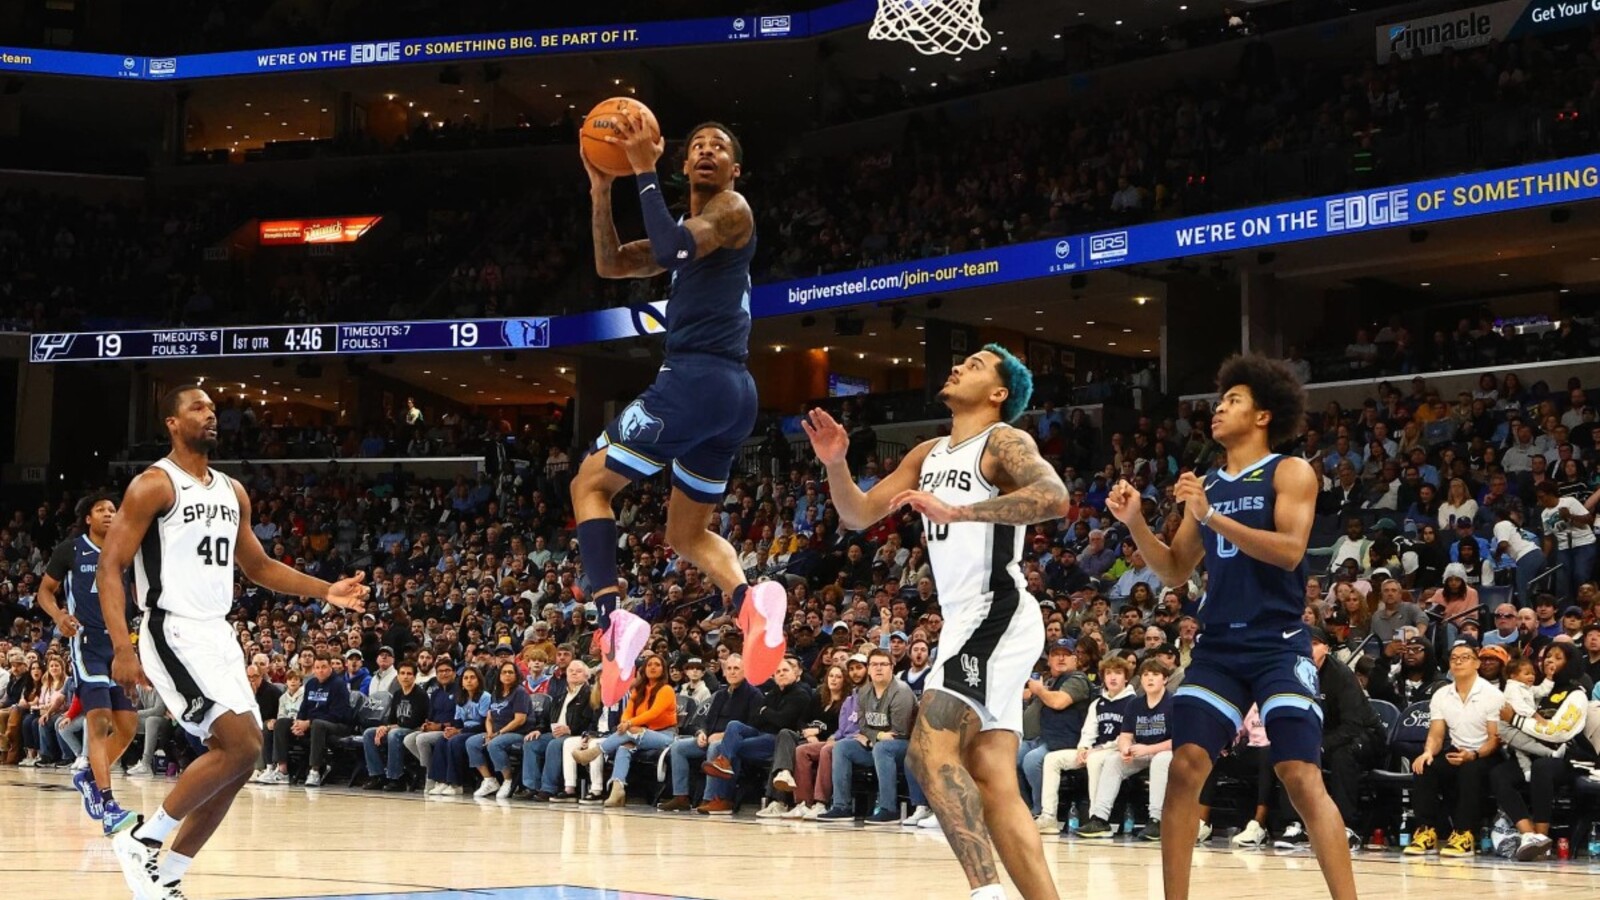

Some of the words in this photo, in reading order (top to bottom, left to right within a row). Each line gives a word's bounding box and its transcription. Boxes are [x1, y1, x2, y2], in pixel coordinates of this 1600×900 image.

[762, 17, 788, 27] BRS
[1531, 7, 1555, 23] Get
[1559, 1, 1588, 17] Your
[1388, 12, 1491, 52] Pinnacle
[257, 53, 295, 67] WE'RE
[299, 51, 318, 64] ON
[321, 49, 346, 62] THE
[350, 42, 400, 64] EDGE
[404, 44, 422, 57] OF
[425, 38, 506, 55] SOMETHING
[510, 36, 537, 49] BIG.
[541, 35, 558, 47] BE
[562, 32, 598, 45] PART
[601, 30, 619, 43] OF
[623, 29, 639, 41] IT.
[1176, 222, 1236, 247] WE'RE
[1241, 217, 1270, 238] ON
[1276, 209, 1318, 233] THE
[1325, 189, 1409, 232] EDGE
[1416, 190, 1446, 212] OF
[1453, 167, 1598, 207] SOMETHING
[1092, 235, 1125, 252] BRS
[788, 261, 999, 305] bigriversteel.com/join-our-team
[152, 332, 209, 343] TIMEOUTS:
[210, 331, 218, 341] 6
[284, 328, 322, 351] 4:46
[342, 325, 403, 337] TIMEOUTS:
[403, 325, 411, 336] 7
[448, 323, 478, 347] 19
[95, 333, 122, 357] 19
[152, 345, 188, 355] FOULS:
[190, 345, 197, 354] 2
[252, 337, 269, 350] QTR
[342, 339, 381, 349] FOULS:
[382, 338, 388, 348] 1
[183, 503, 238, 526] SPURS
[197, 535, 230, 567] 40
